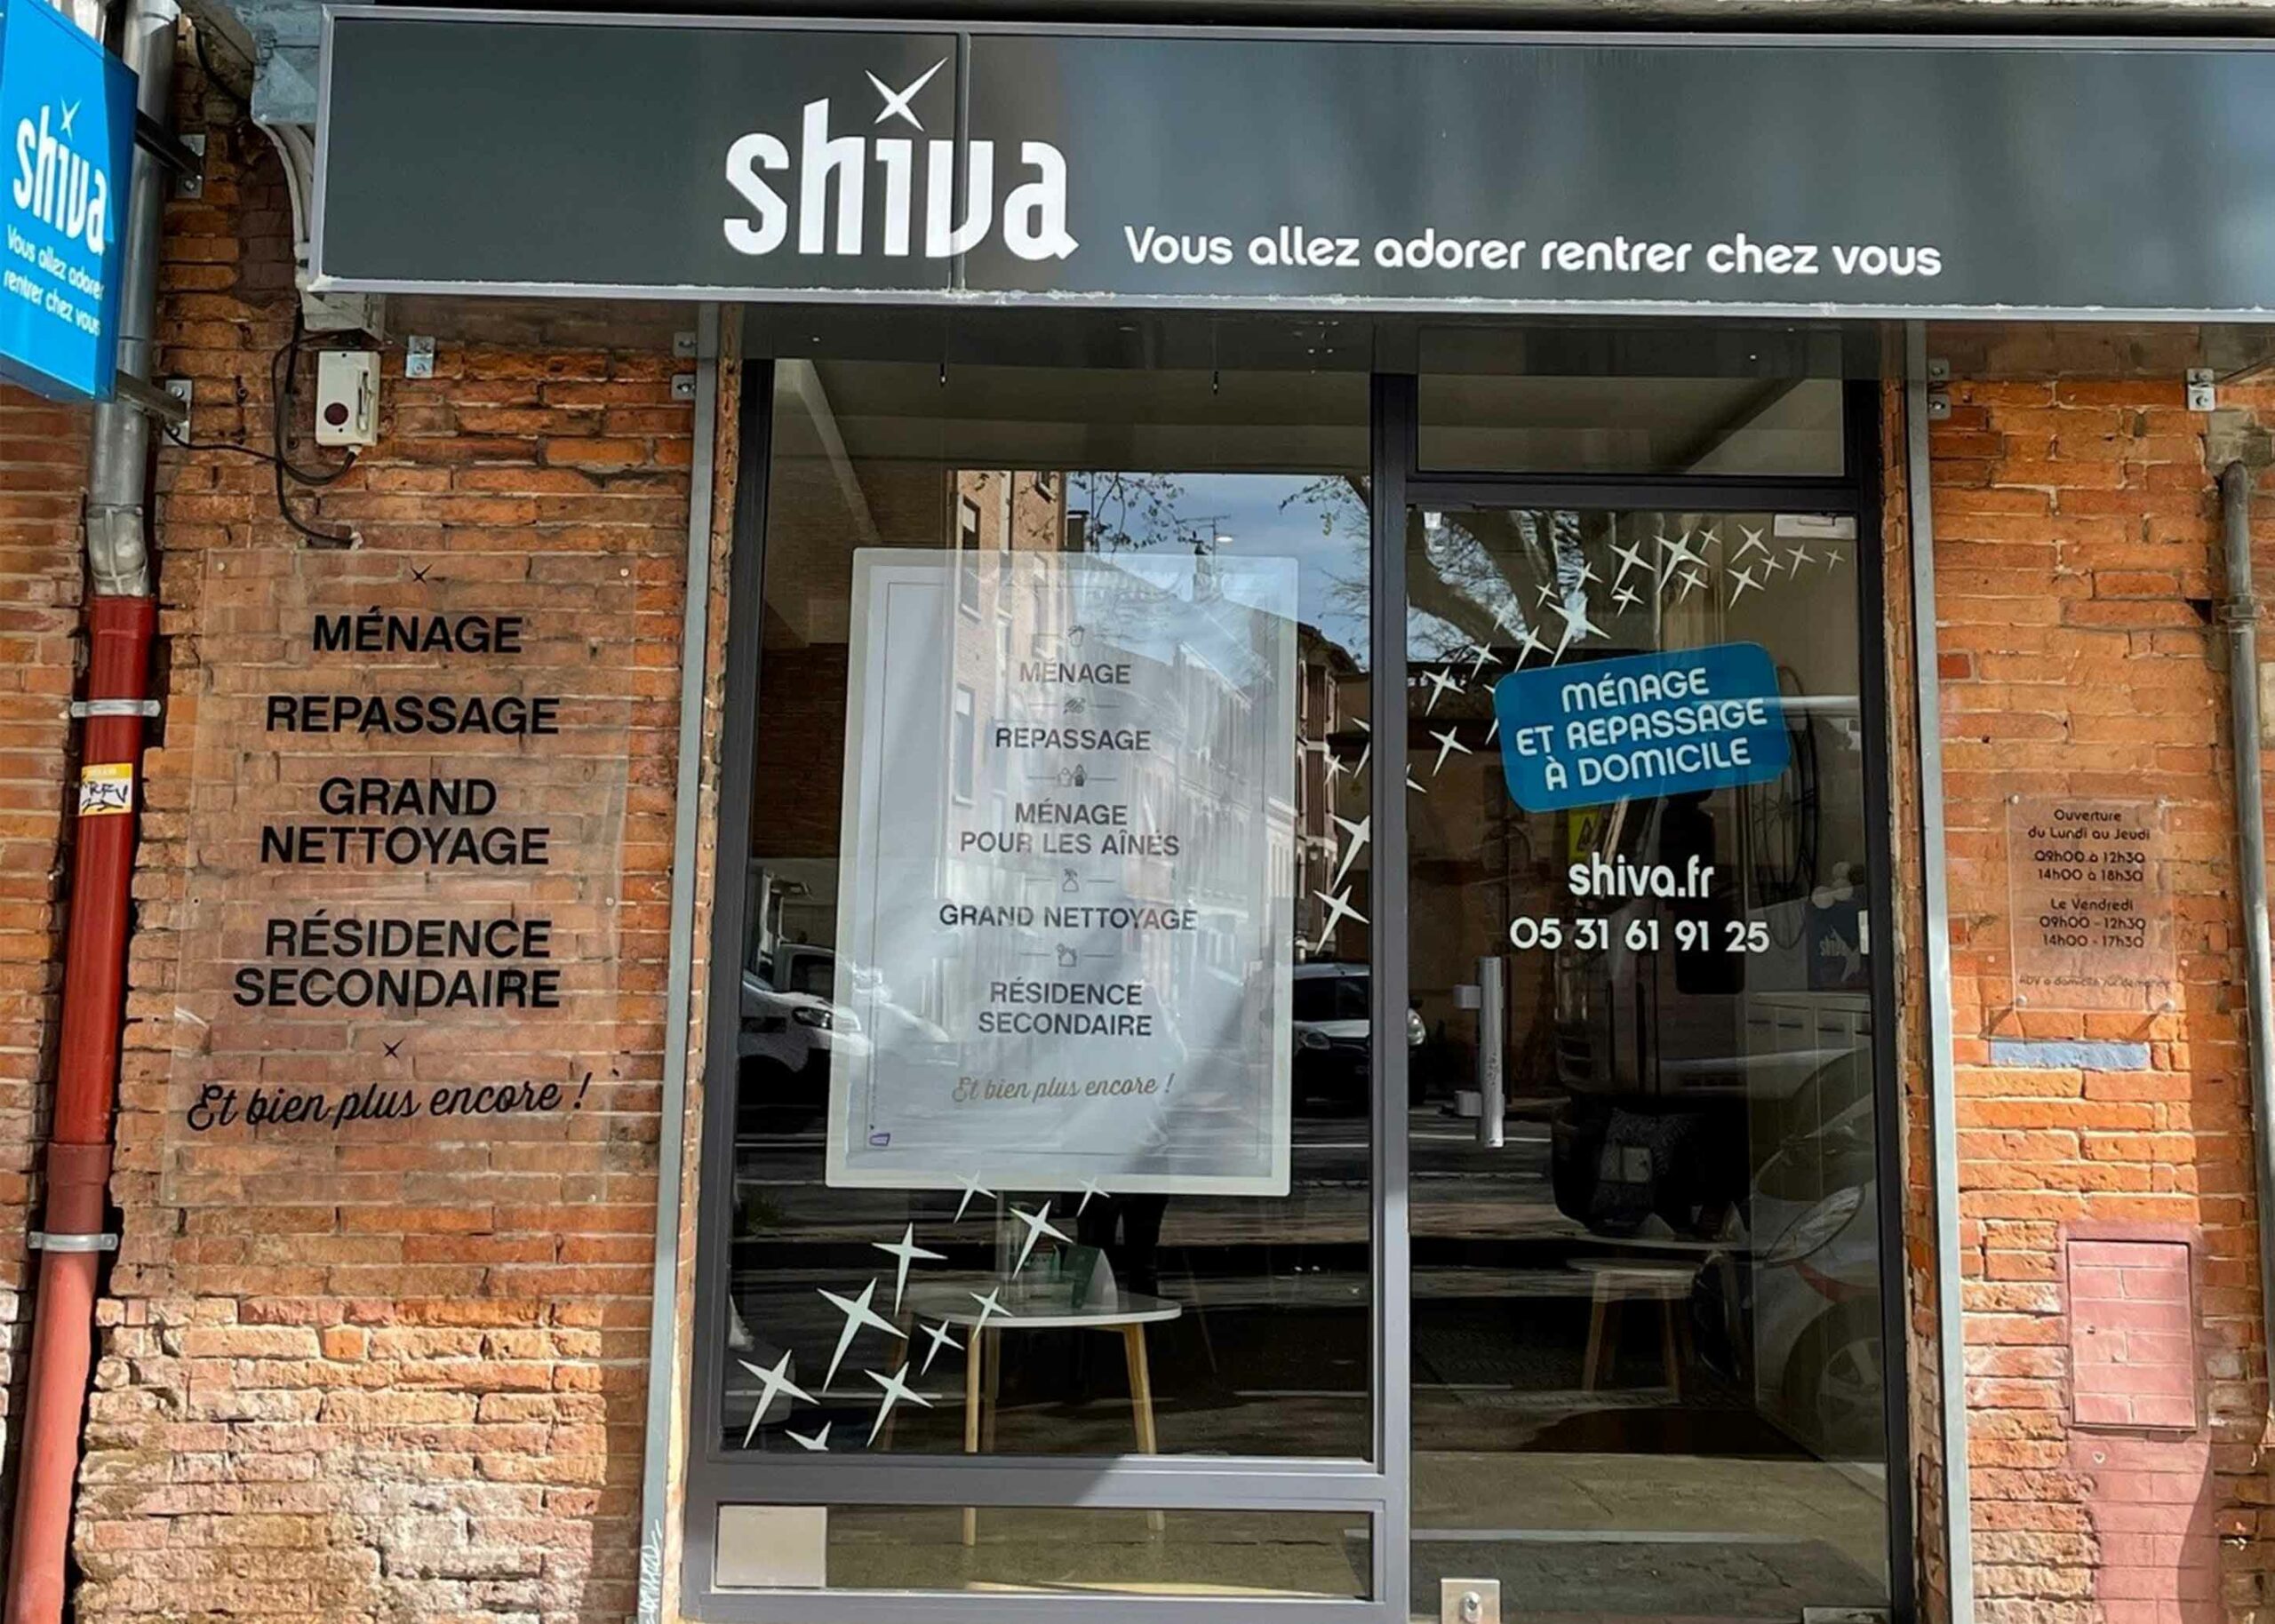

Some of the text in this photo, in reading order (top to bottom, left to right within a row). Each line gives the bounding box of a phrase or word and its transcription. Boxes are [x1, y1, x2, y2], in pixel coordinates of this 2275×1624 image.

[13, 105, 107, 256] shiva
[723, 98, 1079, 260] shiva
[7, 224, 104, 300] Vous allez adorer
[1124, 226, 1942, 275] Vous allez adorer rentrer chez vous
[4, 269, 100, 337] rentrer chez vous
[313, 605, 523, 654] MÉNAGE
[1561, 667, 1710, 712] MÉNAGE
[267, 696, 560, 734] REPASSAGE
[1516, 697, 1768, 757] ET REPASSAGE
[995, 728, 1152, 751] REPASSAGE
[1545, 737, 1751, 791] À DOMICILE
[319, 777, 498, 816] GRAND
[1015, 798, 1128, 825] MÉNAGE
[2054, 809, 2122, 821] Ouverture
[260, 825, 550, 865] NETTOYAGE
[961, 830, 1180, 856] POUR LES AÎNÉS
[2028, 826, 2151, 840] du Lundi au Jeudi
[1569, 852, 1714, 898] shiva.fr
[2034, 850, 2085, 863] 09h00
[2103, 851, 2145, 864] 12h30
[2039, 868, 2083, 880] 14h00
[2102, 870, 2143, 881] 18h30
[939, 904, 1198, 931] GRAND NETTOYAGE
[2040, 916, 2090, 928] 09h00
[2103, 918, 2146, 930] 12h30
[2051, 898, 2134, 911] Le Vendredi
[266, 909, 552, 958] RÉSIDENCE
[1511, 917, 1770, 952] 05 31 61 91 25
[2044, 935, 2088, 947] 14h00
[2103, 935, 2144, 948] 17h30
[233, 967, 561, 1007] SECONDAIRE
[991, 977, 1143, 1006] RÉSIDENCE
[978, 1012, 1153, 1036] SECONDAIRE
[187, 1071, 594, 1131] Et bien plus encore !
[952, 1072, 1175, 1103] Et bien plus encore !
